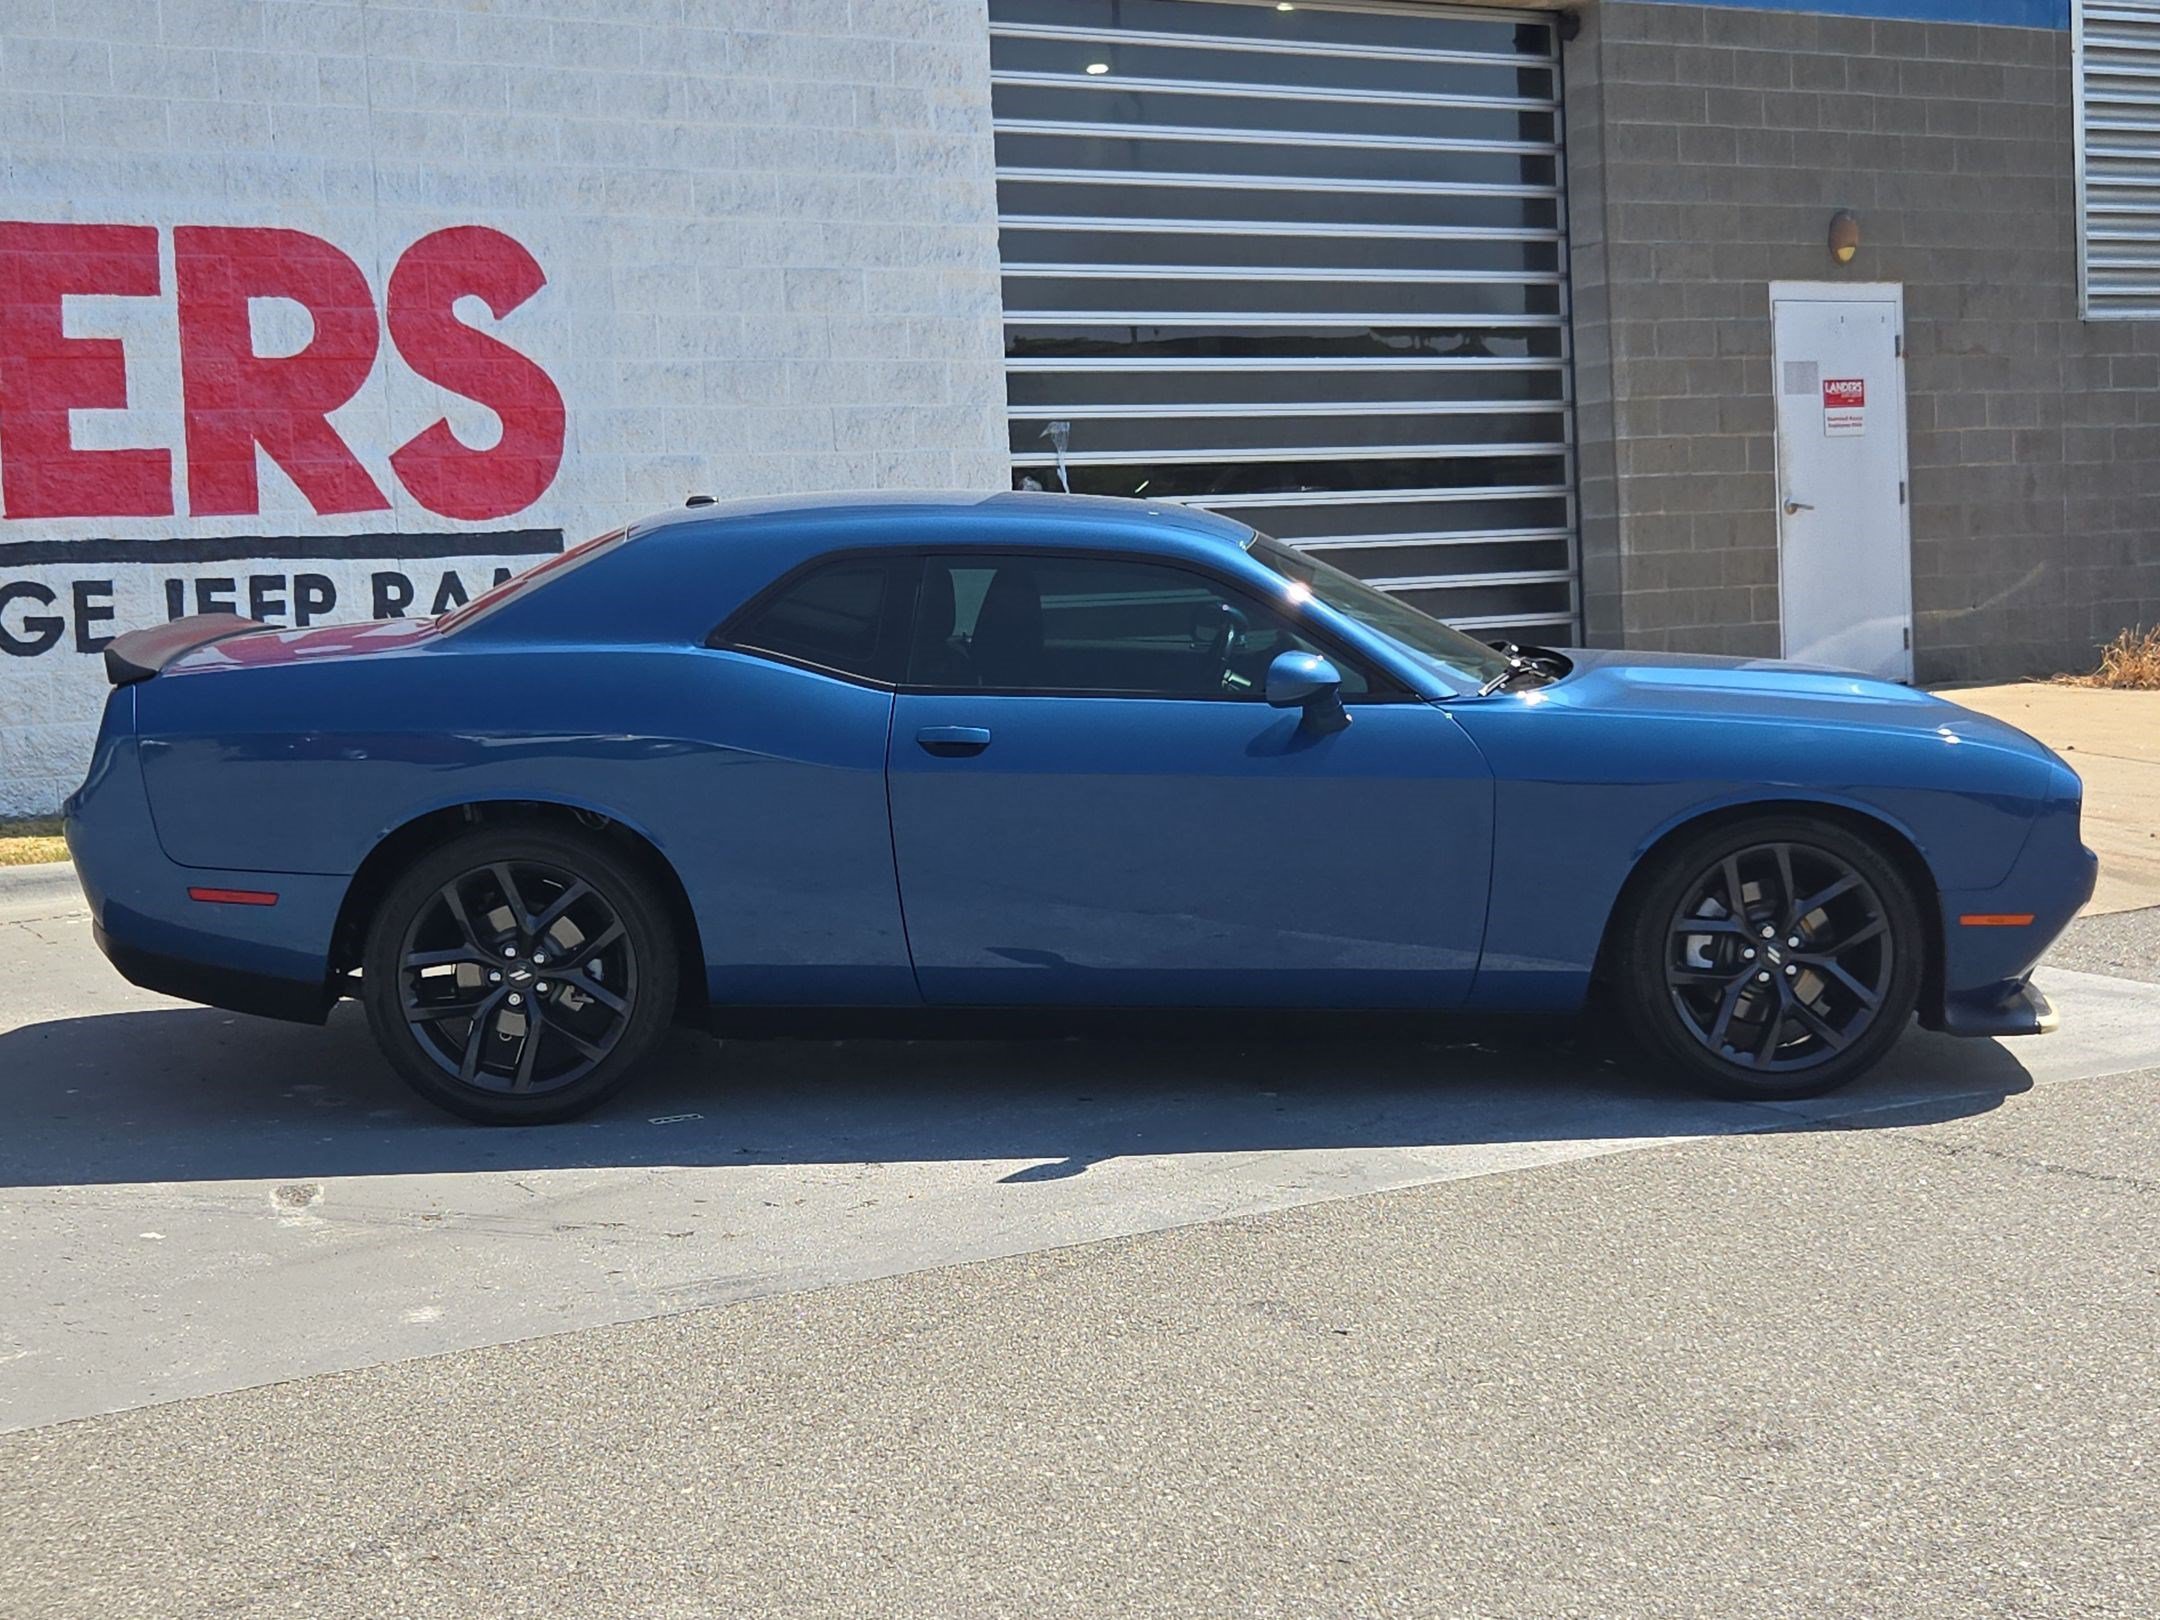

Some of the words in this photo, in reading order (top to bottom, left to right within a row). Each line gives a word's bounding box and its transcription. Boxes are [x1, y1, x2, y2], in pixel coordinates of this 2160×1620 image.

[0, 221, 566, 521] ERS
[1825, 381, 1862, 394] LANDERS
[371, 567, 513, 620] RA
